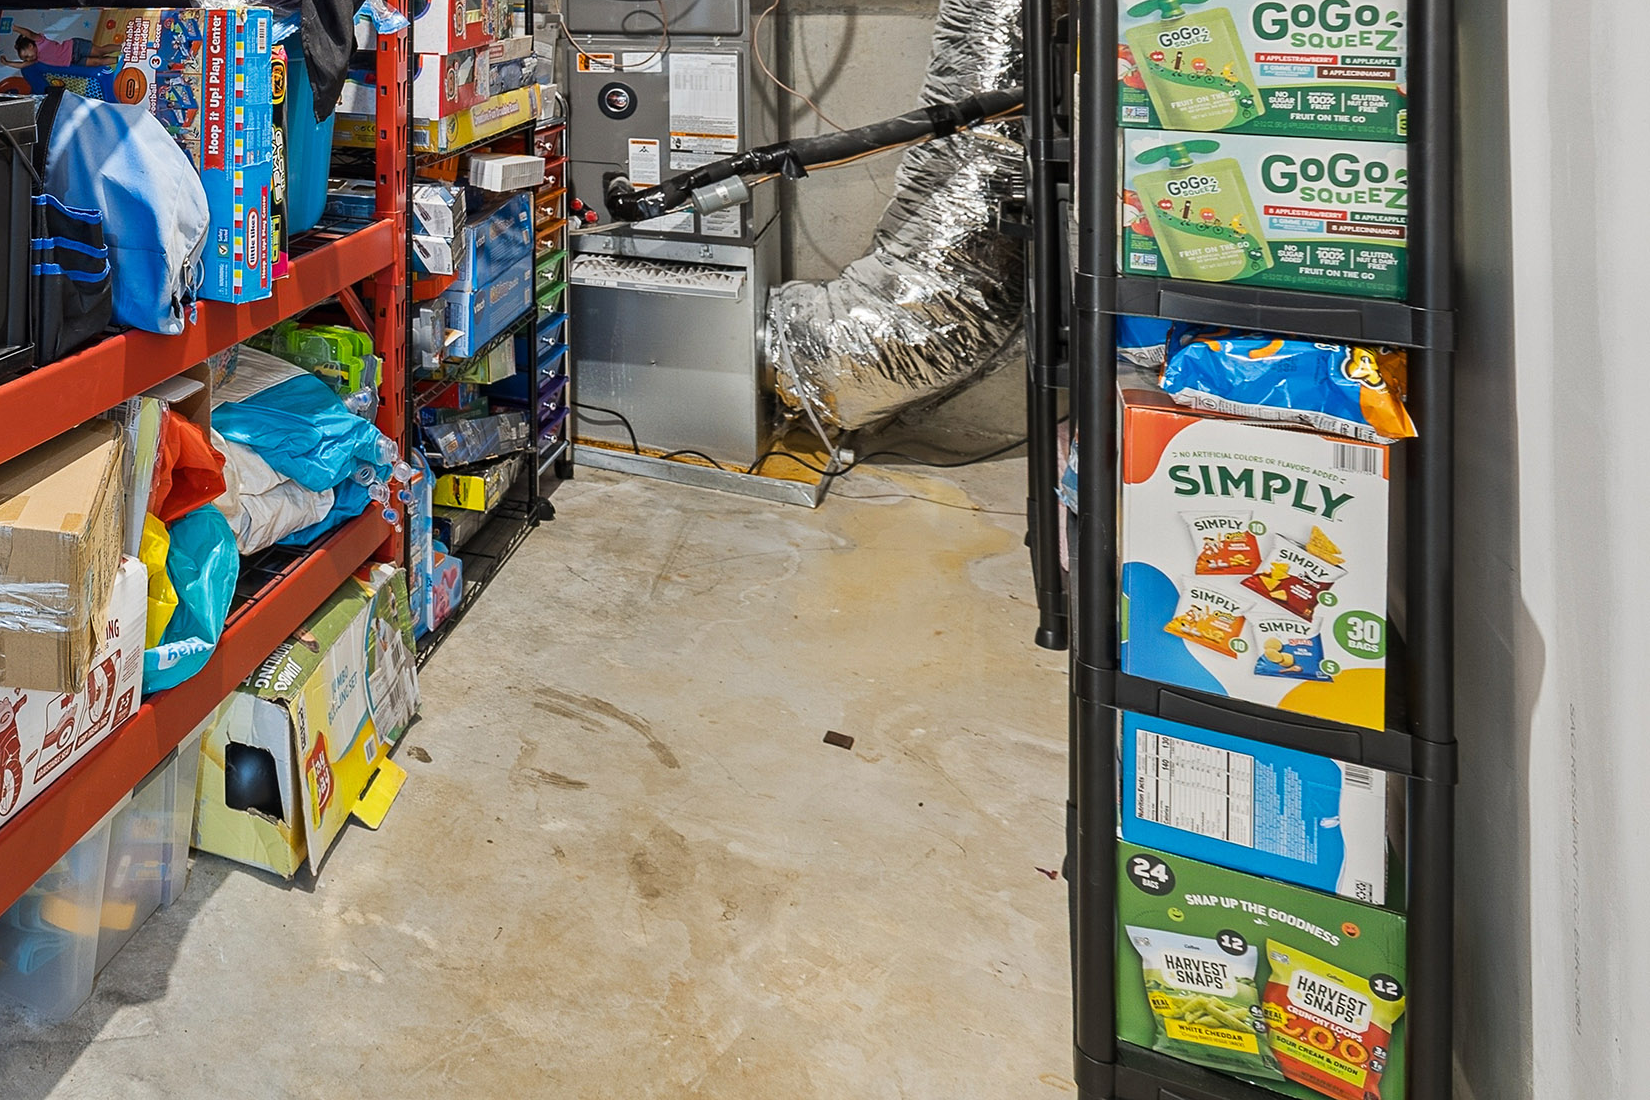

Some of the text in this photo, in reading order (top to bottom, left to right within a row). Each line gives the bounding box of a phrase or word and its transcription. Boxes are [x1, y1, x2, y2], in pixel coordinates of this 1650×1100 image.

[124, 21, 134, 62] Inflatable
[131, 17, 142, 62] Basketball
[140, 20, 150, 59] Included!
[154, 24, 162, 49] Soccer
[1159, 27, 1200, 47] GoGo
[1290, 30, 1398, 51] SQUEEZ
[208, 15, 223, 155] Hoop it Up! Play Center
[149, 83, 157, 115] ootball
[1171, 100, 1194, 109] FRUIT
[1307, 96, 1336, 105] 100%
[1290, 113, 1315, 121] FRUIT
[1261, 153, 1389, 194] GoGo
[1167, 176, 1209, 196] GoGo
[1299, 187, 1407, 209] SQUEEZ
[1275, 209, 1343, 219] APPLESTRAWBERRY
[1361, 215, 1406, 223] APPLEAPPLE
[1339, 226, 1400, 235] APPLECINNAMON
[1179, 249, 1202, 258] FRUIT
[1299, 267, 1324, 275] FRUIT
[1326, 269, 1340, 277] ON
[1342, 270, 1359, 278] THE
[1192, 451, 1232, 460] ARTIFICIAL
[1234, 454, 1264, 463] COLORS
[1277, 460, 1311, 473] FLAVORS
[1312, 470, 1339, 482] ADDED
[1168, 464, 1355, 520] SIMPLY
[1194, 517, 1243, 531] SIMPLY
[1251, 522, 1263, 533] 10
[1279, 549, 1329, 578] SIMPLY
[1190, 589, 1240, 613] SIMPLY
[1323, 592, 1332, 604] 5
[1258, 622, 1311, 636] SIMPLY
[1347, 617, 1380, 645] 30
[1232, 641, 1245, 651] 10
[1348, 641, 1379, 653] BAGS
[273, 656, 302, 692] JUMBO
[1326, 662, 1334, 673] 5
[348, 671, 358, 693] SET
[1162, 736, 1170, 749] 130
[1133, 857, 1169, 883] 24
[1142, 878, 1159, 890] BAGS
[1184, 893, 1340, 947] SNAP UP THE GOODNESS
[1221, 934, 1244, 951] 12
[1165, 954, 1228, 979] HARVEST
[1177, 971, 1223, 989] SNAPS
[1374, 979, 1399, 996] 12
[1297, 975, 1367, 1016] HARVEST
[1304, 992, 1354, 1023] SNAPS
[1178, 1024, 1203, 1034] WHITE
[1205, 1029, 1244, 1042] CHEDDAR
[1287, 1005, 1363, 1043] CRUNCHY LOOPS
[1276, 1035, 1297, 1048] SOUR
[1298, 1044, 1325, 1060] CREAM
[1333, 1060, 1359, 1075] ONION
